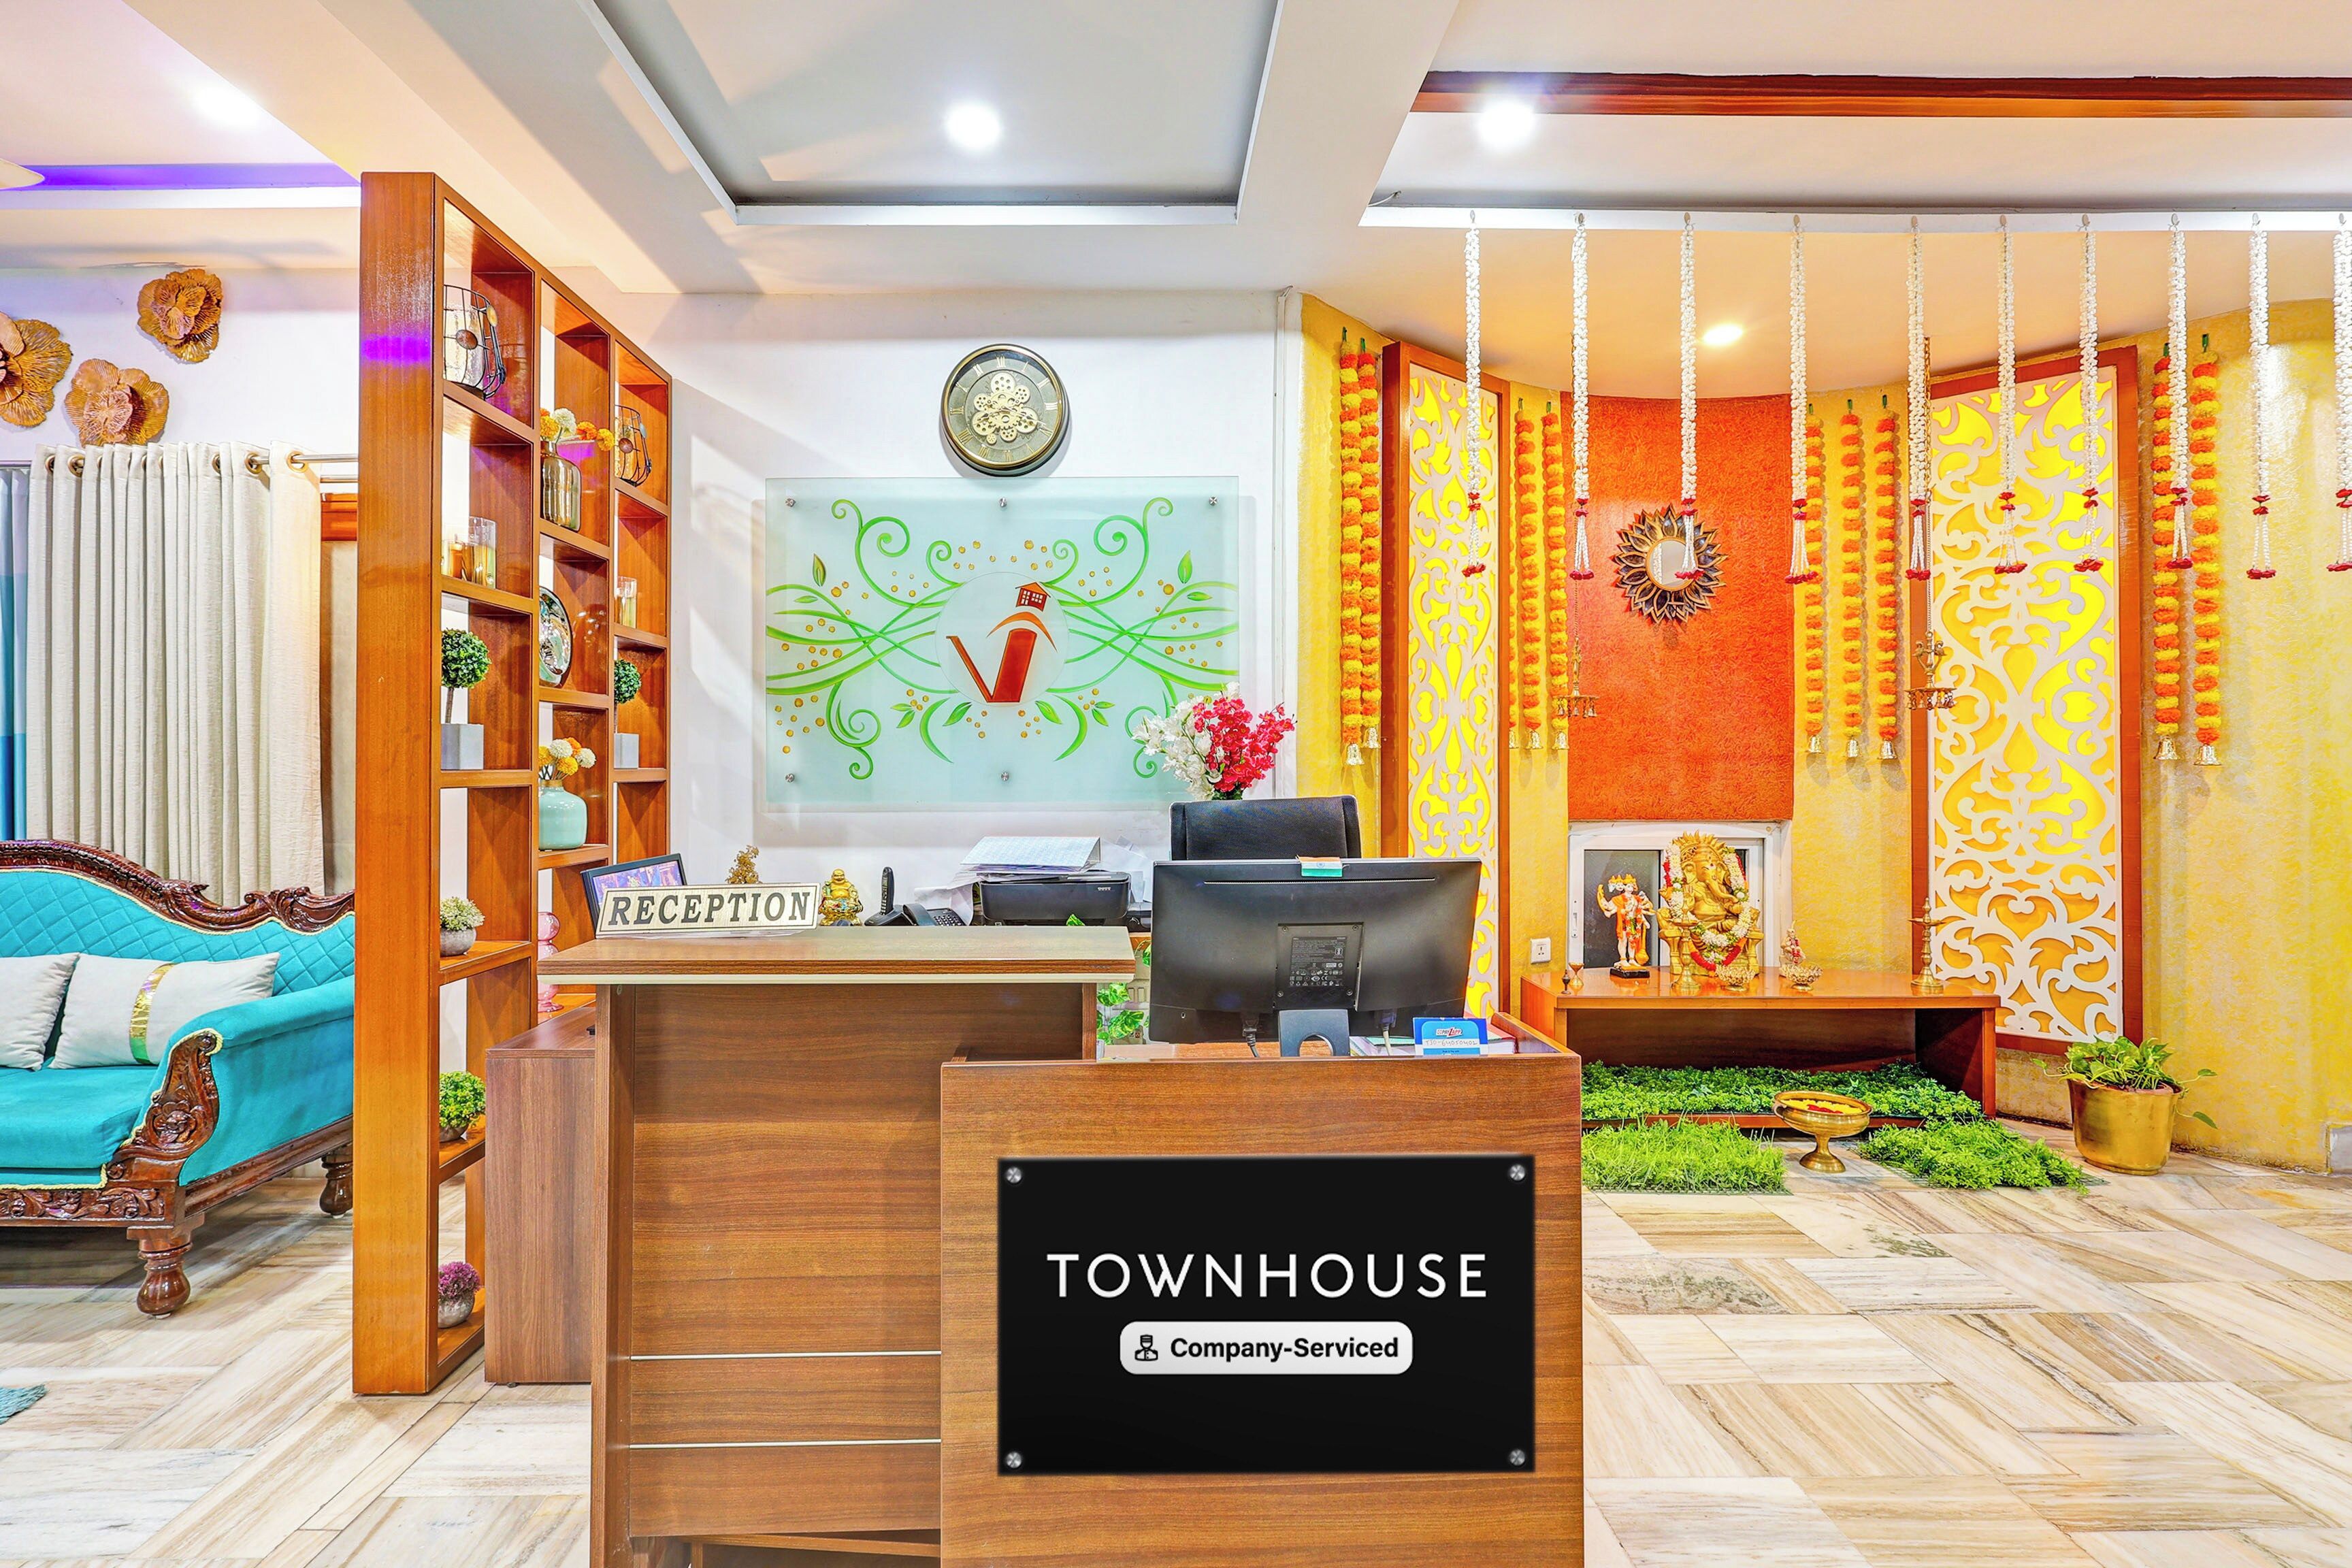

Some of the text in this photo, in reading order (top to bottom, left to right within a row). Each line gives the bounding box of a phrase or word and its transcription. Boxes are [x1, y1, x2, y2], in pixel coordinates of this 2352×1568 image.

[608, 892, 811, 926] RECEPTION
[1047, 1253, 1486, 1298] TOWNHOUSE
[1170, 1337, 1399, 1362] Company-Serviced
